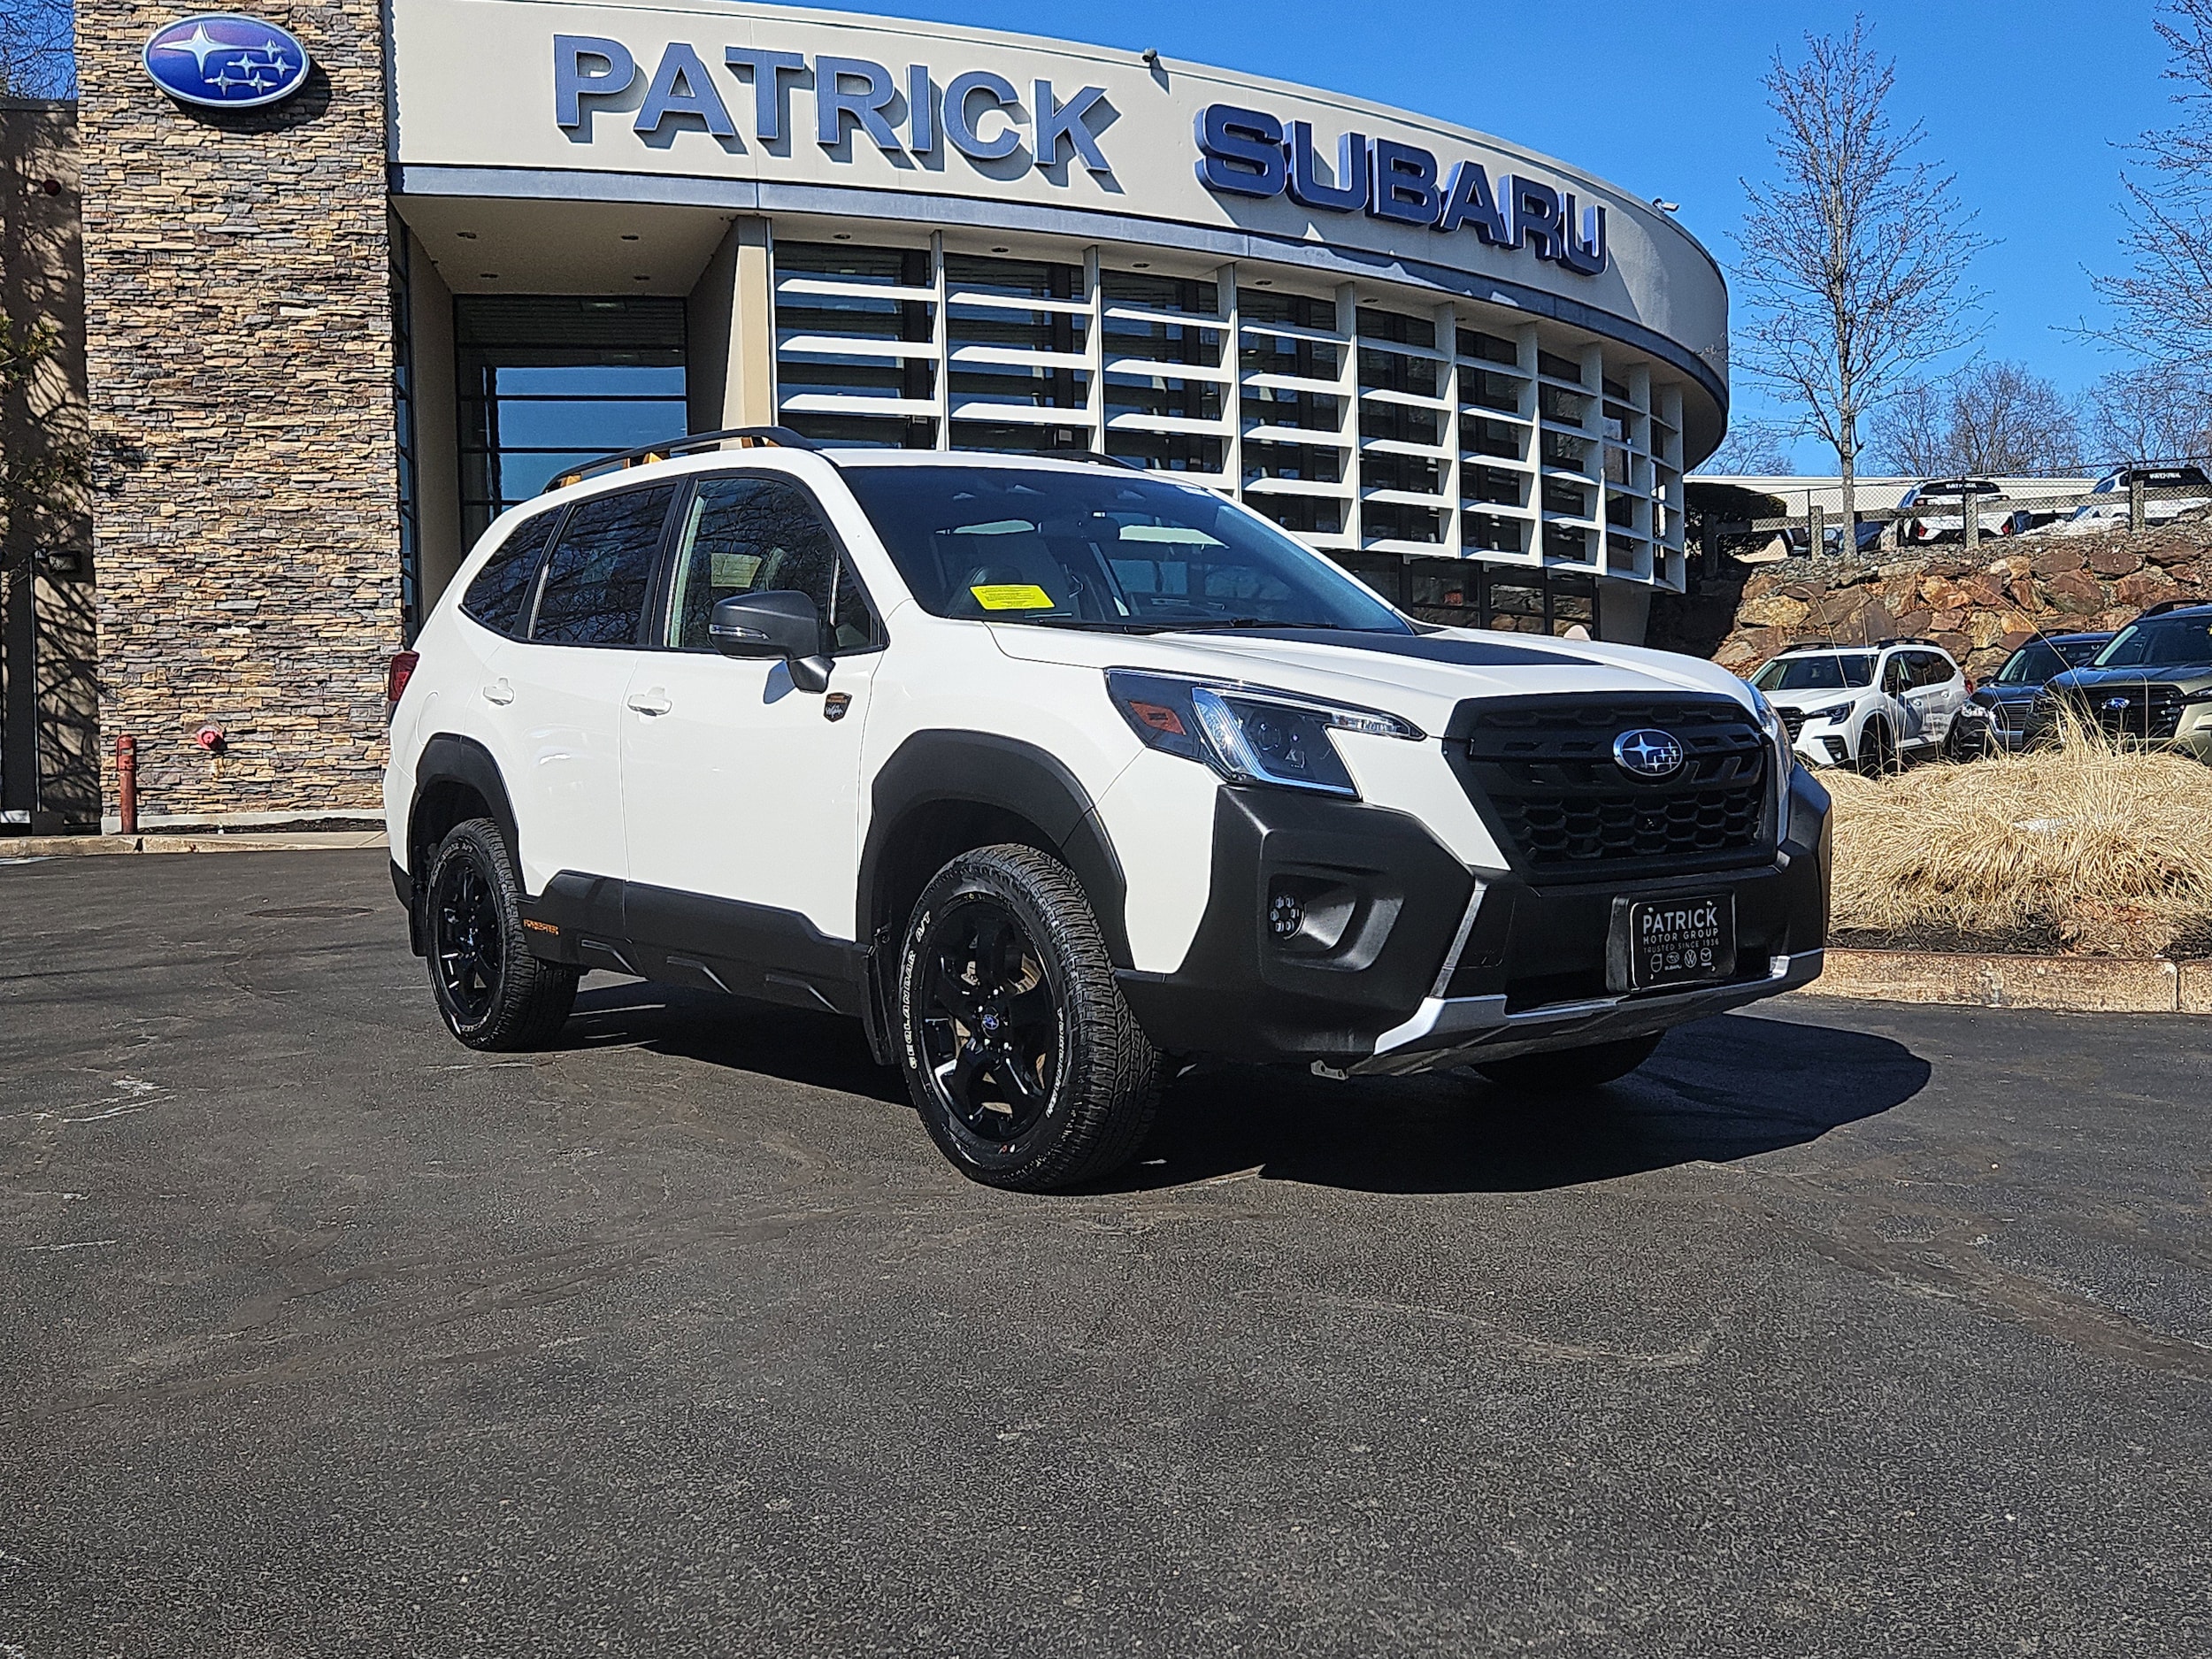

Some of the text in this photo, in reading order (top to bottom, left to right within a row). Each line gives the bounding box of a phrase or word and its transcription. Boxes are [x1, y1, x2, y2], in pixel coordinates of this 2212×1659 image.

[553, 34, 1608, 276] PATRICK SUBARU
[1643, 907, 1717, 934] PATRICK
[1643, 927, 1718, 945] MOTOR GROUP
[1643, 944, 1675, 954] TRUSTED
[1678, 941, 1699, 950] SINCE
[902, 910, 931, 1069] GEOLANDAR A/T
